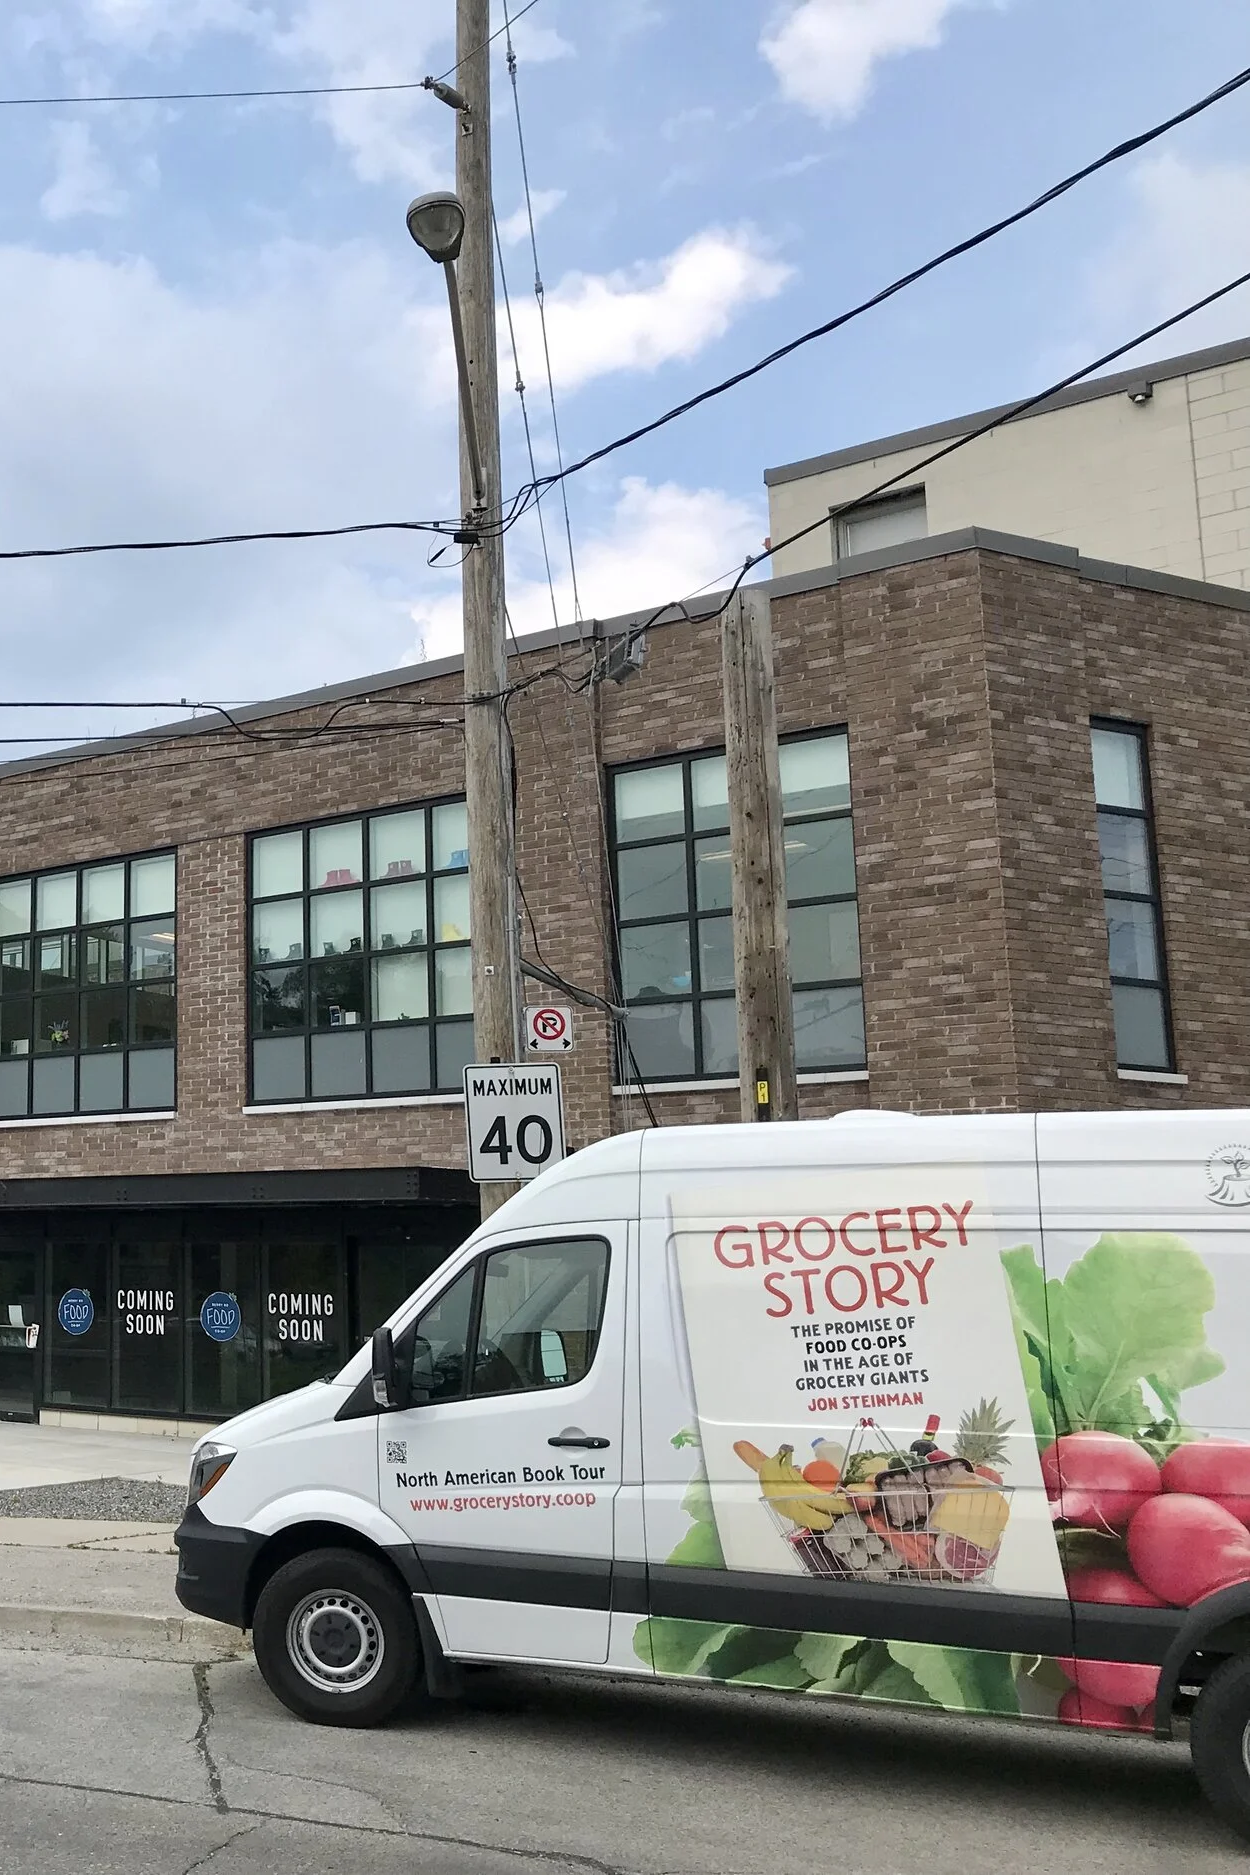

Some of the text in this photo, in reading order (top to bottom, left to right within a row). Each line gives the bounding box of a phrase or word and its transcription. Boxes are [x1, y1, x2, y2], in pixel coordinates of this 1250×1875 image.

[472, 1077, 552, 1097] MAXIMUM
[759, 1083, 766, 1092] P
[479, 1114, 553, 1165] 40
[713, 1200, 973, 1269] GROCERY
[763, 1256, 936, 1318] STORY
[117, 1289, 174, 1311] COMING
[268, 1293, 333, 1316] COMING
[63, 1304, 89, 1320] FOOD
[206, 1308, 235, 1326] FOOD
[126, 1313, 165, 1335] SOON
[278, 1318, 323, 1342] SOON
[790, 1316, 916, 1339] THE PROMISE OF
[804, 1334, 907, 1355] FOOD CO-OPS
[803, 1351, 913, 1373] IN THE AGE OF
[795, 1369, 929, 1392] GROCERY GIANTS
[808, 1390, 924, 1412] JON STEINMAN
[396, 1464, 606, 1488] North American Book Tour
[410, 1491, 596, 1512] www.grocerystory.coop
